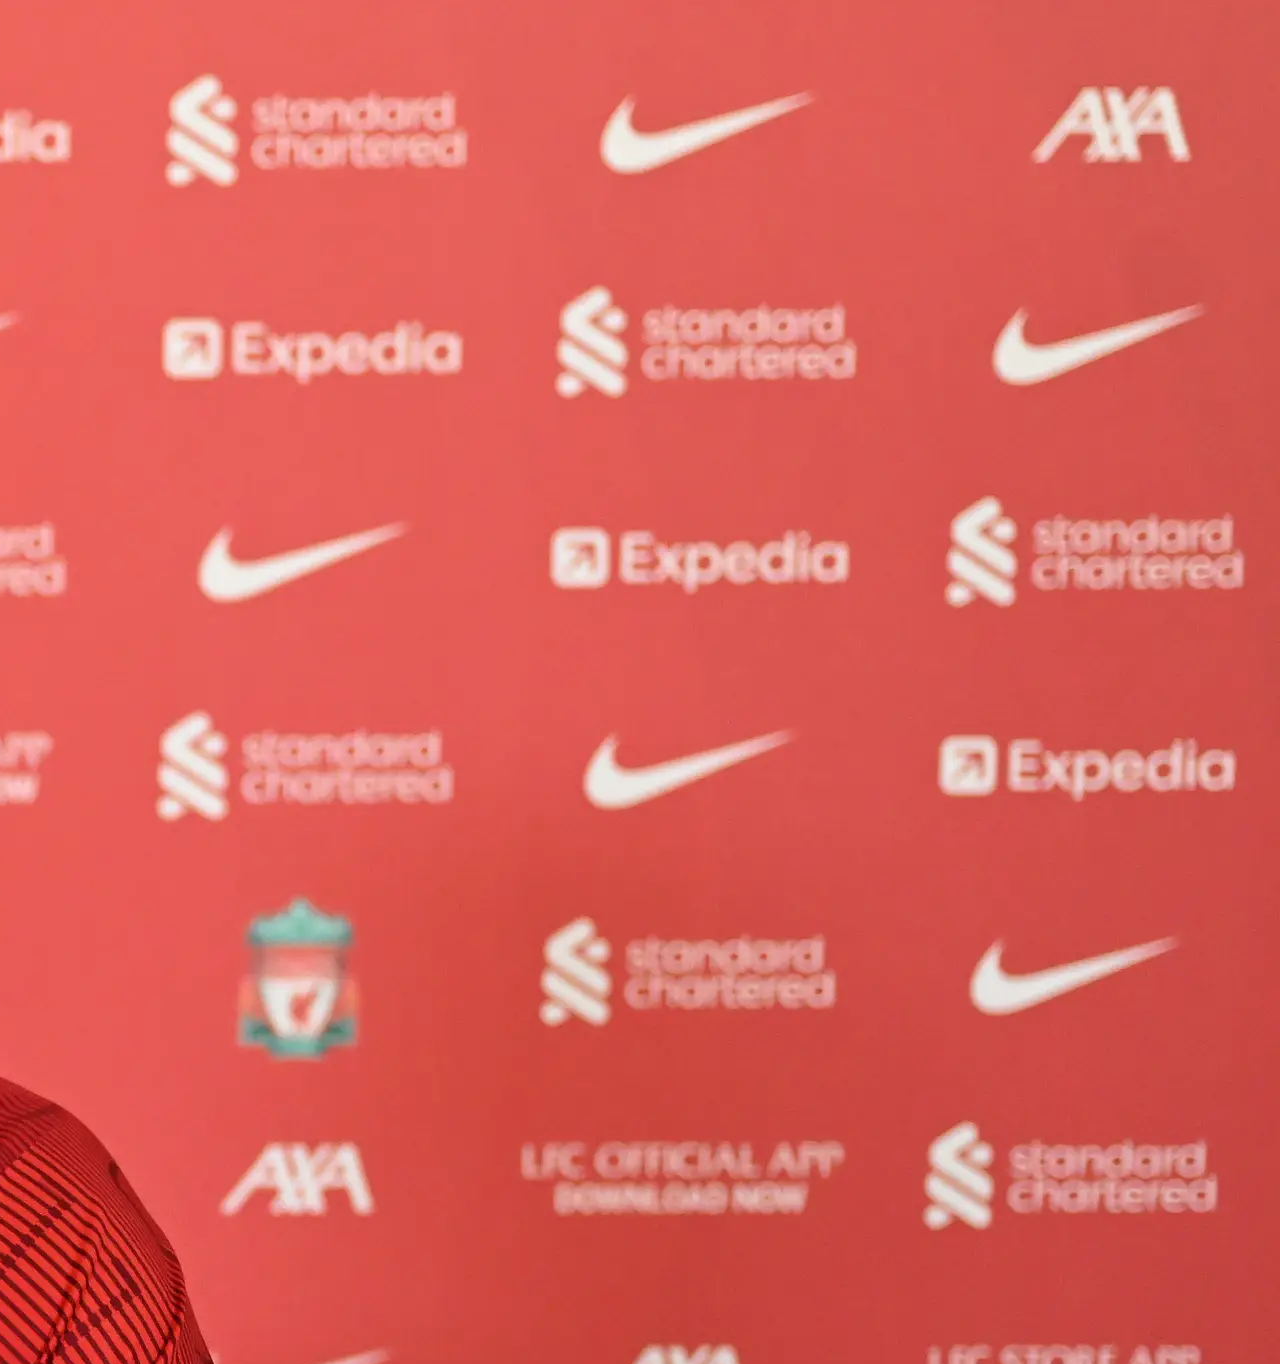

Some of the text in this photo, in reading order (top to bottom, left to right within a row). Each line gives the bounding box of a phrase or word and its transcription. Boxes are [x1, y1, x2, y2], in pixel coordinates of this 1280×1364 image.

[252, 92, 456, 132] standard
[1033, 87, 1190, 163] AXA
[251, 129, 468, 169] chartered
[643, 304, 845, 343] standard
[231, 321, 463, 384] Expedia
[641, 340, 857, 380] chartered
[1033, 514, 1232, 554] standard
[619, 531, 849, 593] Expedia
[1031, 551, 1244, 590] chartered
[242, 730, 442, 768] standard
[240, 765, 454, 804] chartered
[1007, 739, 1236, 801] Expedia
[626, 935, 824, 973] standard
[624, 970, 836, 1009] chartered
[521, 1141, 845, 1180] LFC OFFICIAL APP
[1009, 1140, 1206, 1178] standard
[220, 1143, 373, 1215] AXA
[1007, 1175, 1218, 1213] chartered
